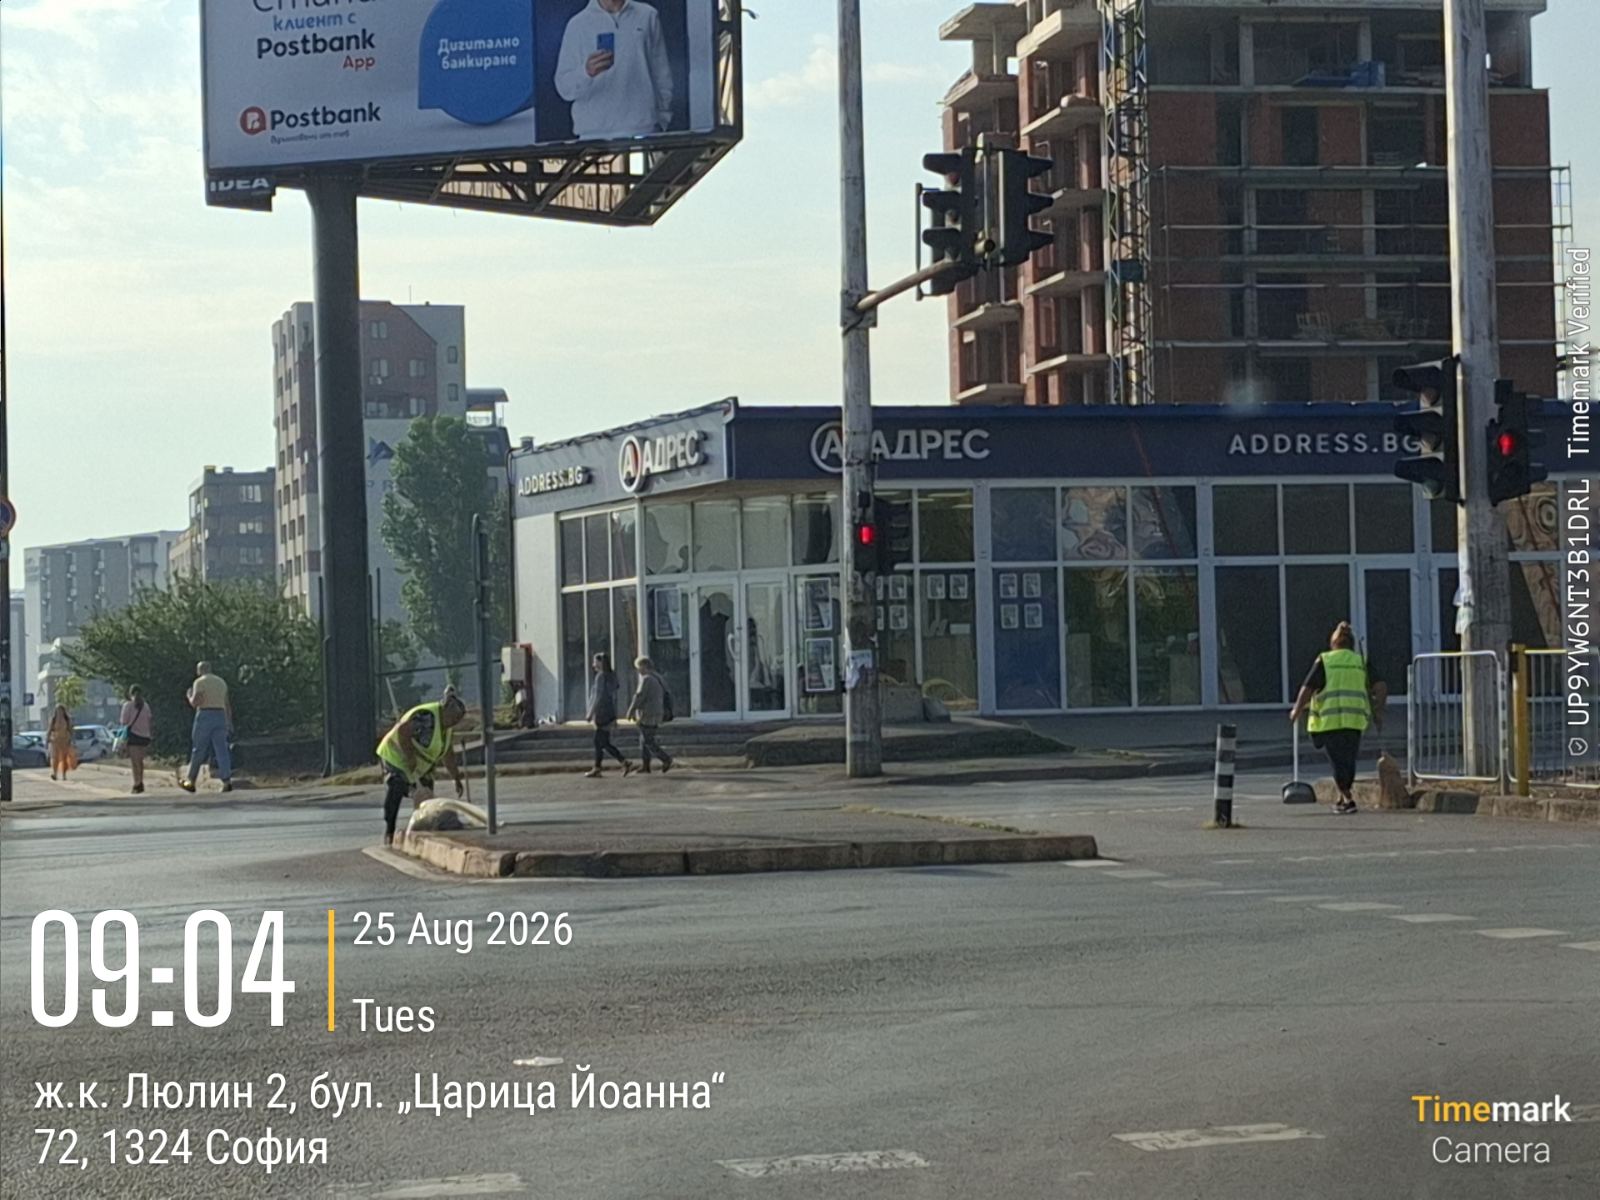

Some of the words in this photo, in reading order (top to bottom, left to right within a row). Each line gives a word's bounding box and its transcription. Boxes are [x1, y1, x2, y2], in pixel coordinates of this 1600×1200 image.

[273, 14, 342, 31] клиент
[256, 28, 375, 59] Postbank
[437, 37, 520, 55] Дигитално
[343, 55, 375, 71] App
[441, 55, 517, 70] банкиране
[270, 101, 381, 130] Postbank
[641, 429, 700, 475] АДРЕС
[870, 428, 990, 460] АДРЕС
[1229, 432, 1422, 455] ADDRESS.BG
[517, 465, 584, 497] ADDRESS.BG
